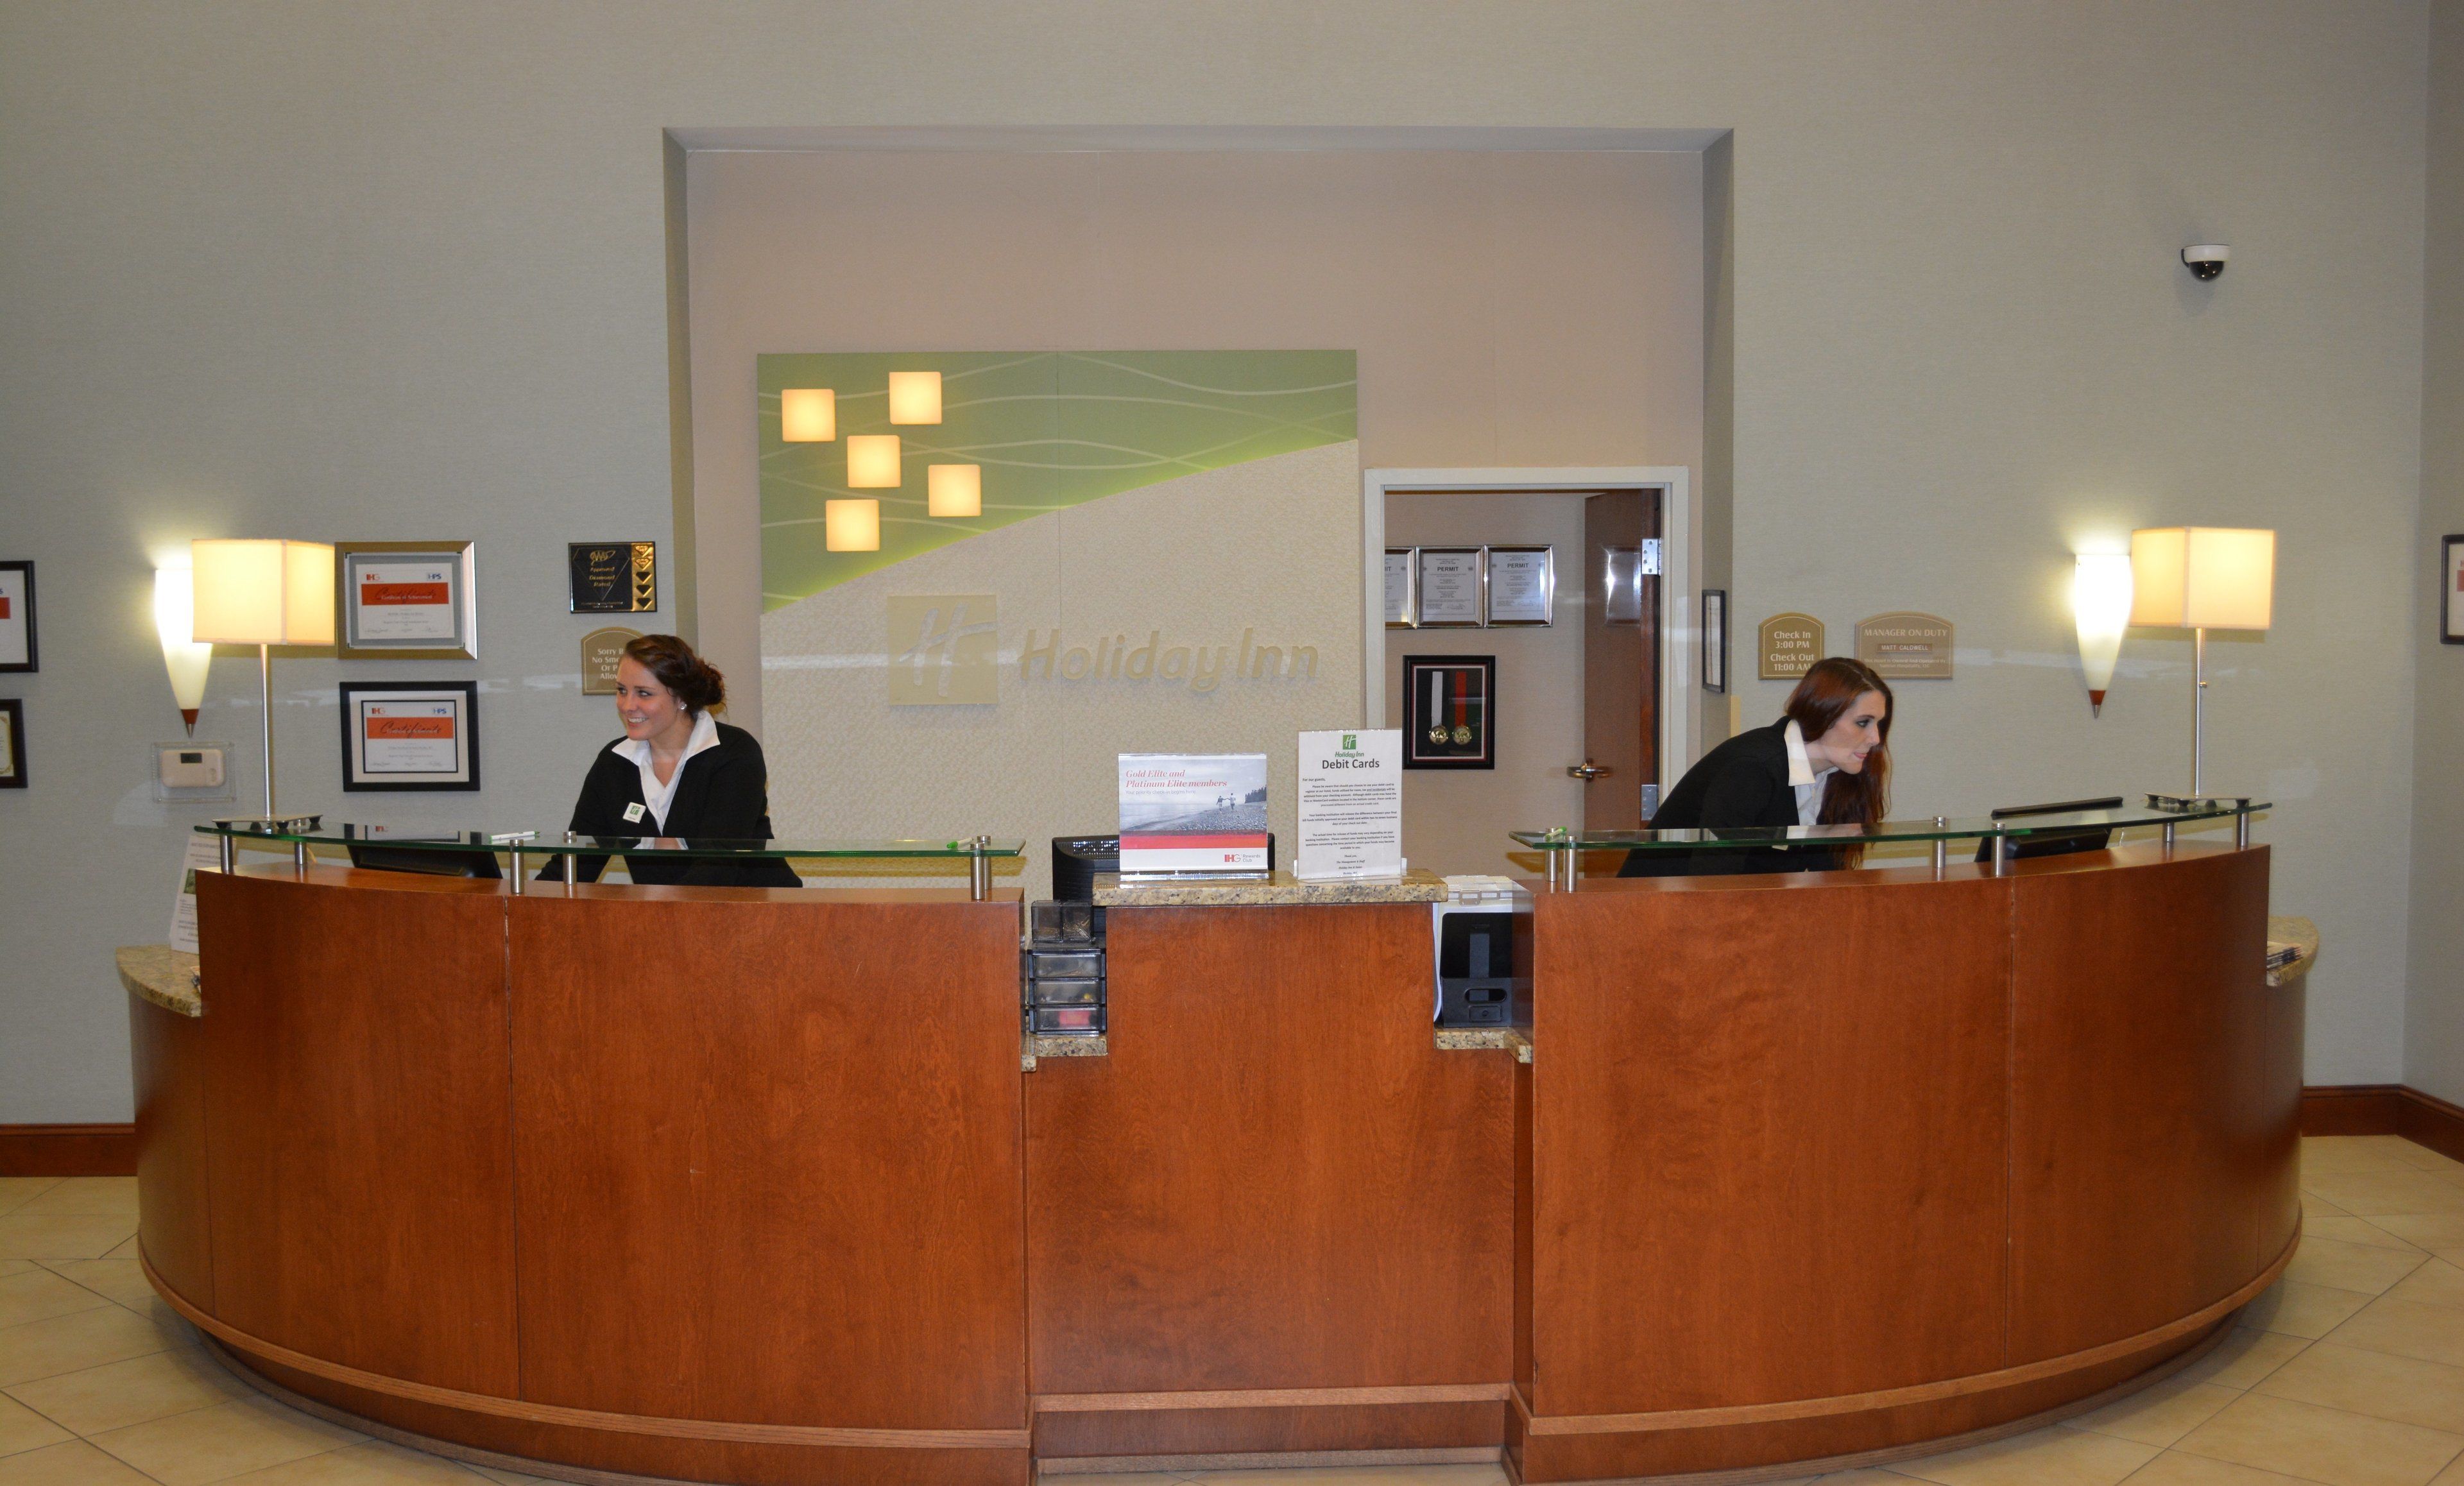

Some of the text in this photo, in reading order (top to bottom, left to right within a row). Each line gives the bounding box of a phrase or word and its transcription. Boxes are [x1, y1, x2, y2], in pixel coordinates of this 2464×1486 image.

[1774, 631, 1811, 639] Check In
[1864, 629, 1906, 637] MANAGER
[1908, 629, 1922, 637] ON
[1775, 640, 1810, 649] 3:00 PM
[1018, 627, 1319, 693] Holiday Inn
[1770, 653, 1796, 662] Check
[1774, 663, 1811, 671] 11:00 AM
[1322, 758, 1380, 769] Debit Cards
[1125, 779, 1228, 789] Platinum Elite members
[1224, 854, 1240, 862] IHG
